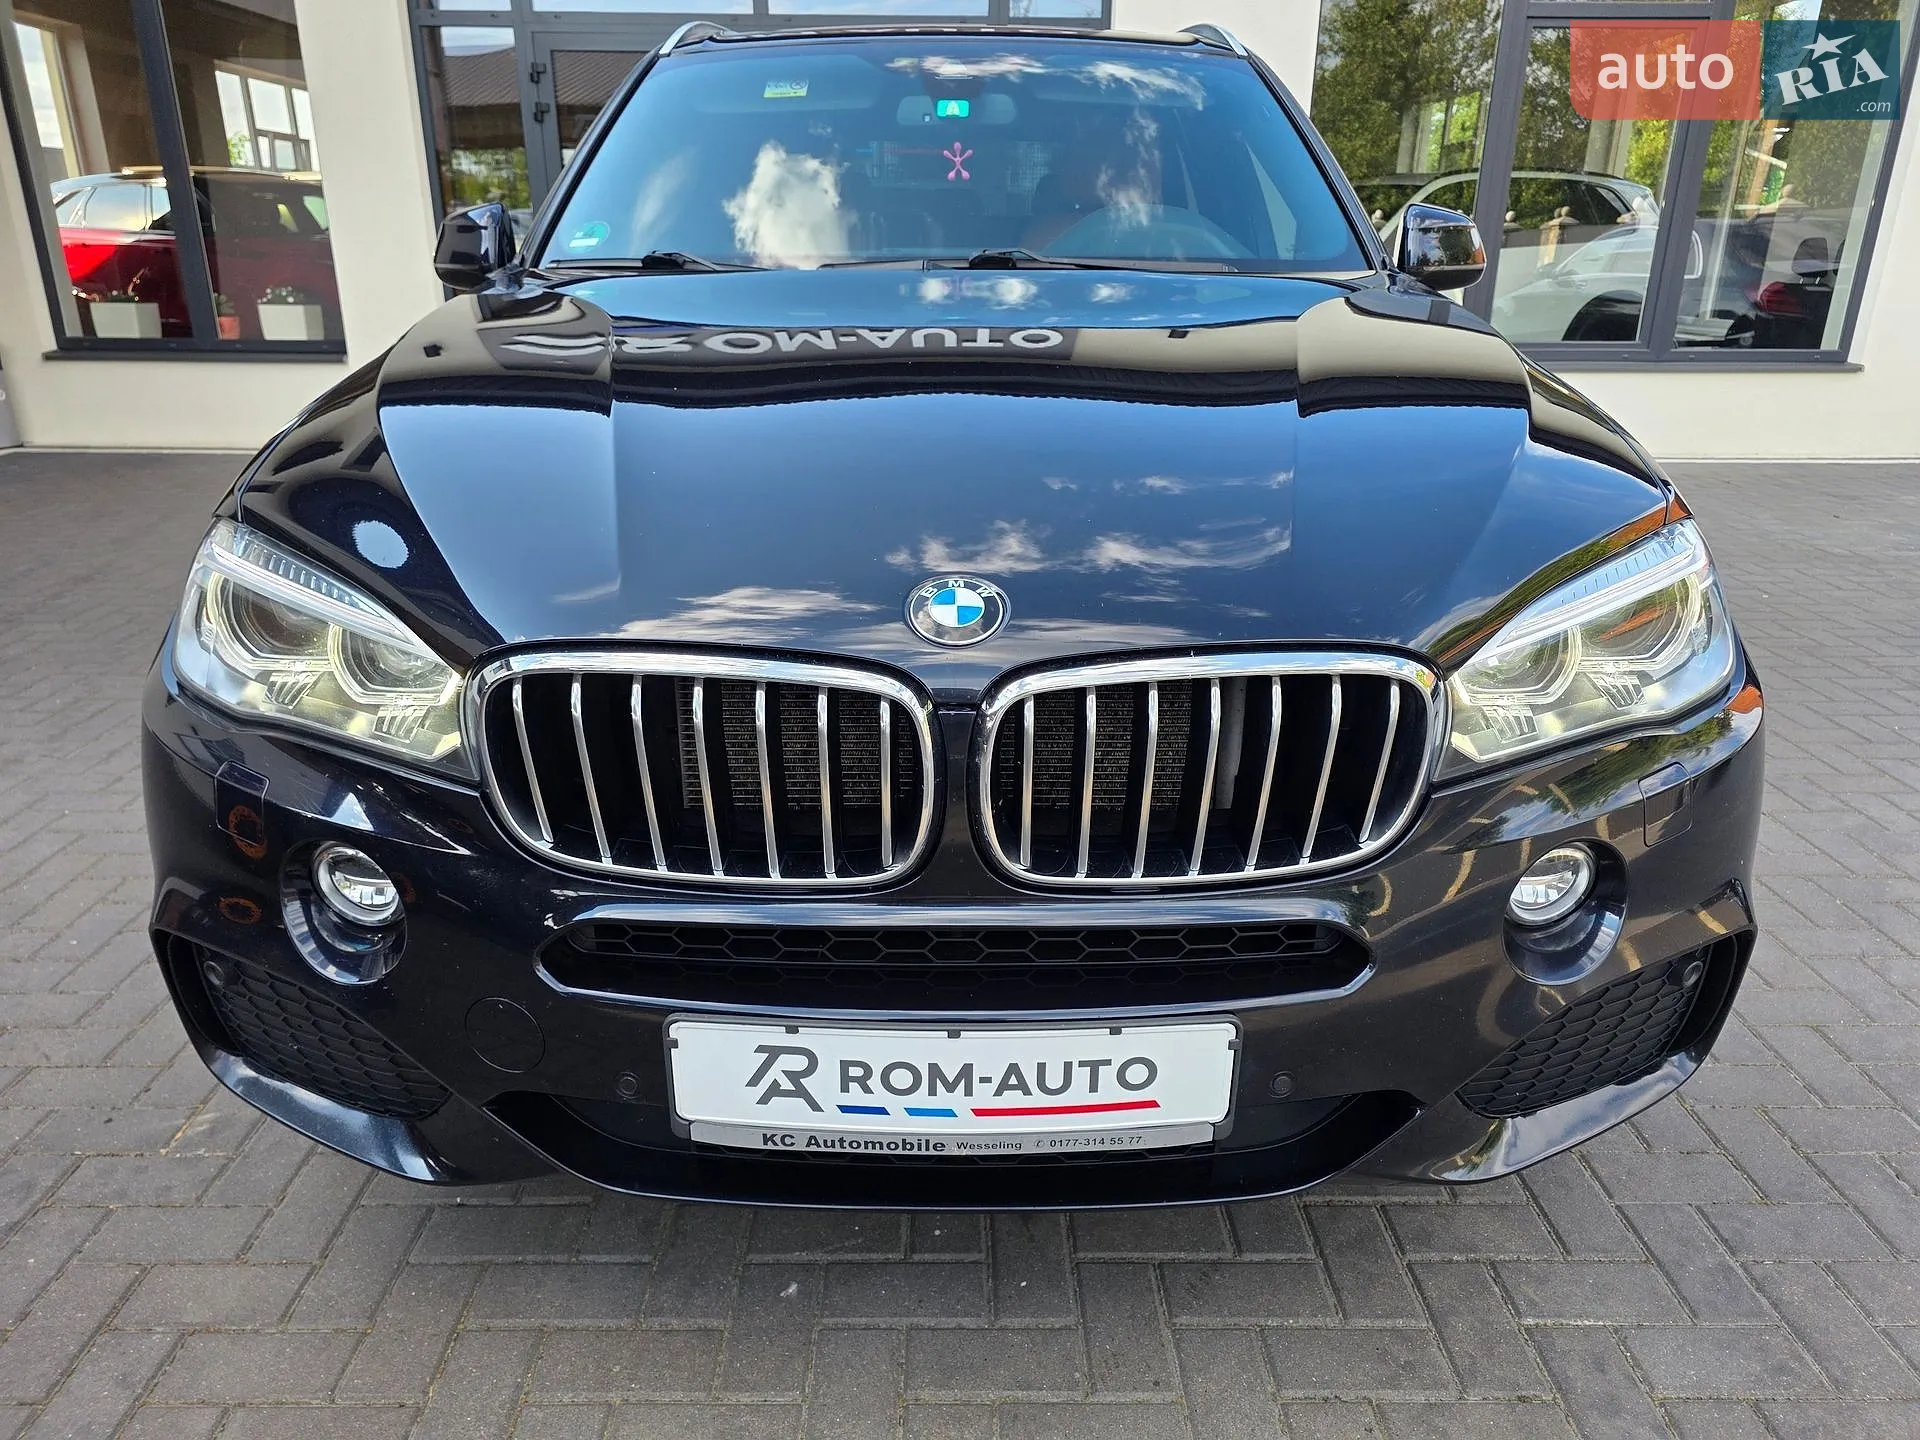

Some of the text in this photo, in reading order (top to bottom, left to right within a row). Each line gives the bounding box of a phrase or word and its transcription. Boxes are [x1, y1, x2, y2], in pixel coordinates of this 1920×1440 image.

[920, 579, 994, 598] BMW
[839, 1056, 1158, 1097] ROM-AUTO
[762, 1133, 1142, 1152] KC Automobile Wesseling 0177-314 55 77
